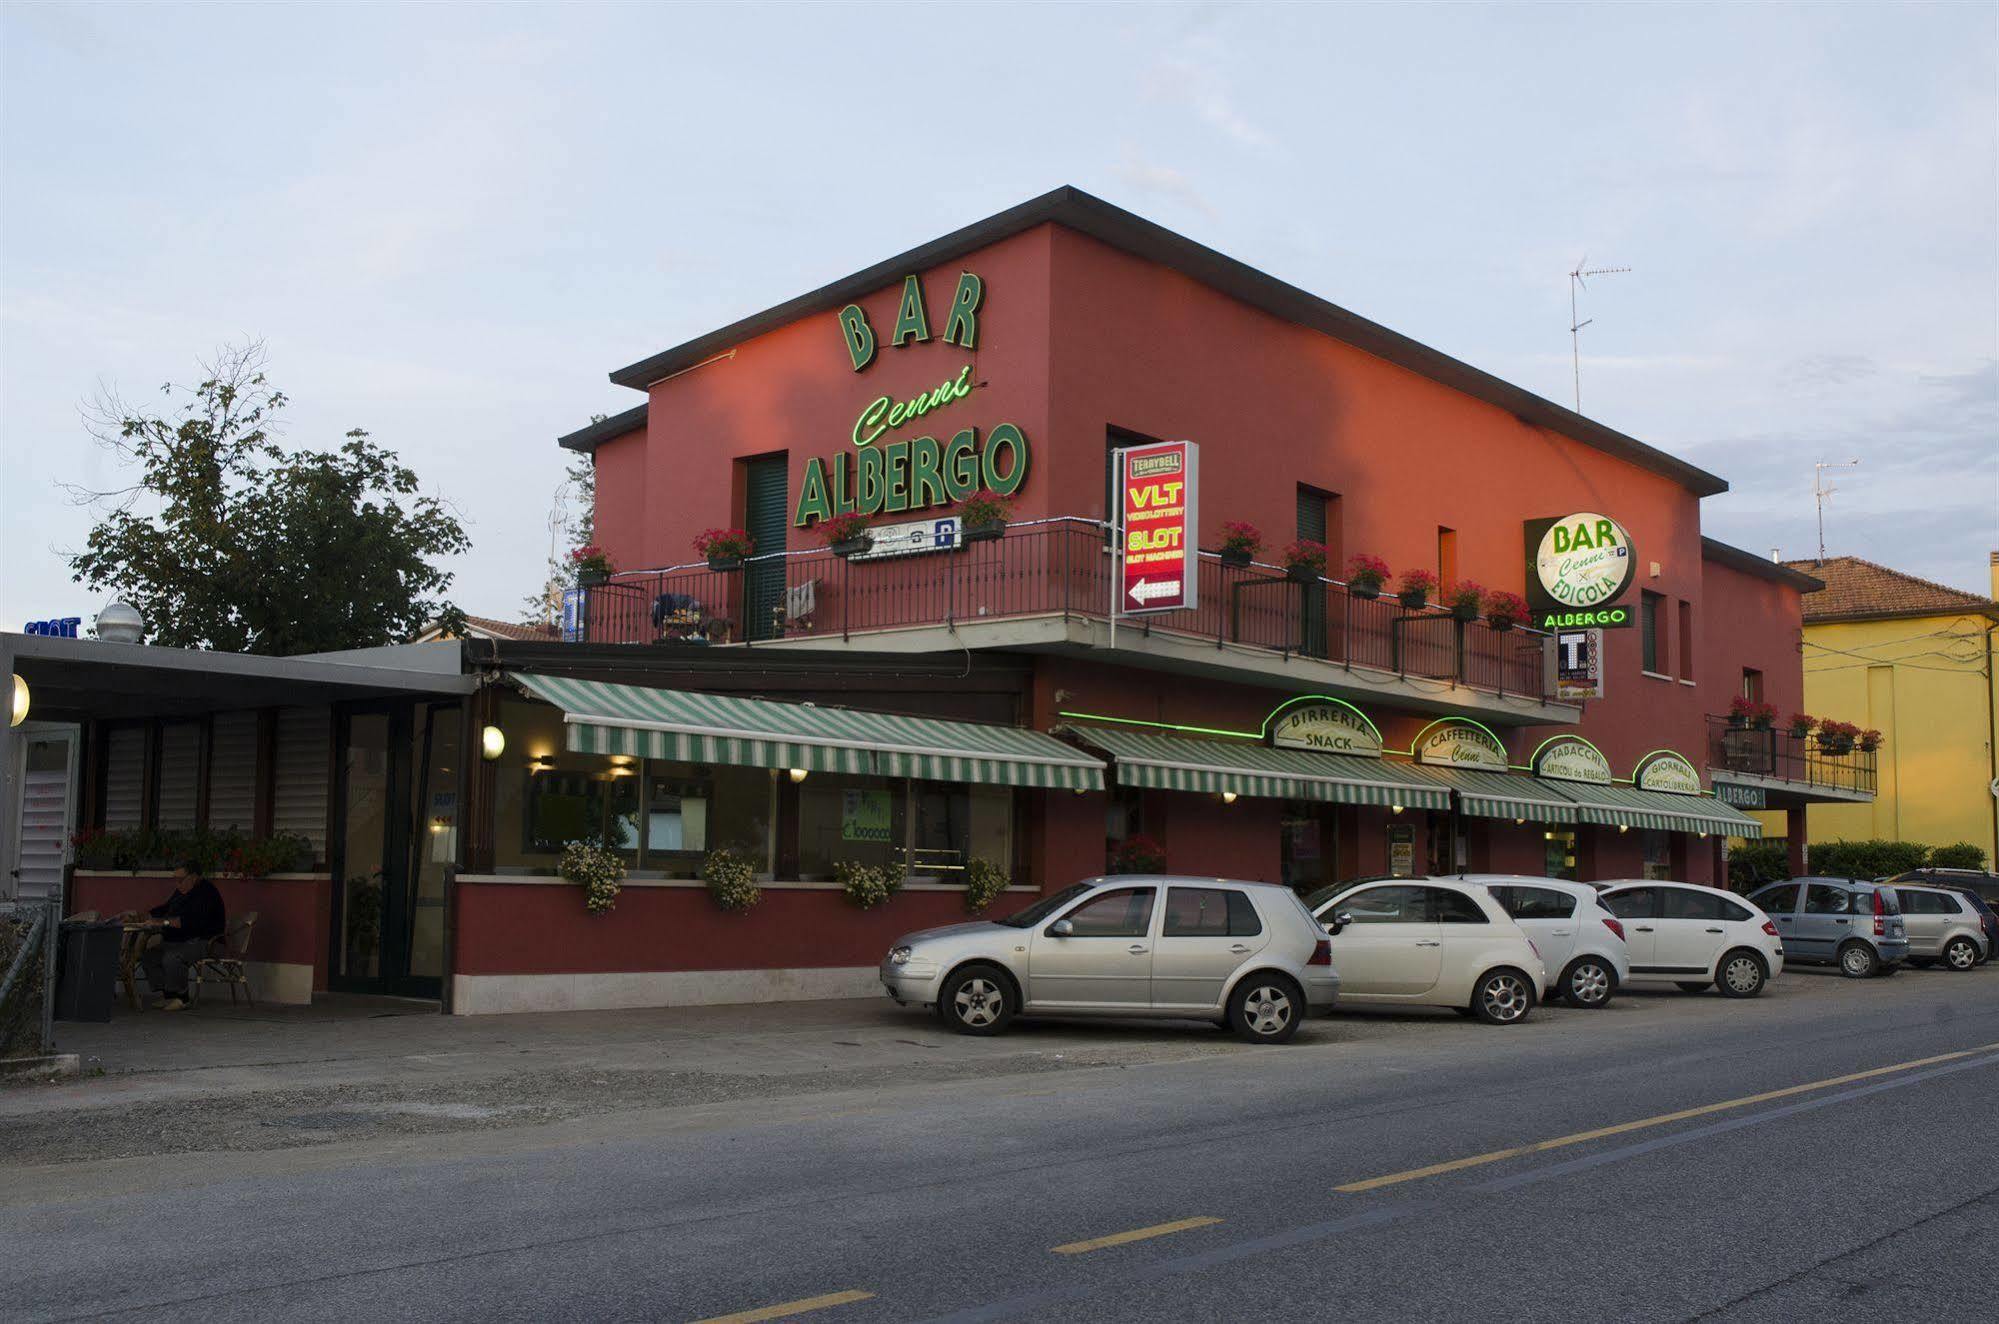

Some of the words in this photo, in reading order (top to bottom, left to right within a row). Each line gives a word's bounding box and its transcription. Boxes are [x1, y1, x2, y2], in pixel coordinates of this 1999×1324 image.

[838, 272, 982, 371] BAR
[852, 366, 969, 446] Cenni
[794, 423, 1027, 526] ALBERGO
[1133, 455, 1179, 471] TERRYBELL
[1129, 482, 1183, 508] VLT
[1128, 527, 1182, 551] SLOT
[1553, 520, 1617, 554] BAR
[1559, 549, 1607, 577] Cenni
[1552, 576, 1617, 604] EDICOLA
[1544, 610, 1625, 627] ALBERGO
[1560, 634, 1585, 669] T
[1291, 709, 1367, 736] BIRRERIA
[1306, 734, 1353, 750] SNACK
[1431, 729, 1500, 757] CAFFETTERIA
[1451, 744, 1480, 762] Cenni
[1552, 746, 1601, 766] TABACCHI
[1652, 761, 1691, 778] GIORNALI
[1716, 784, 1758, 806] ALBERGO
